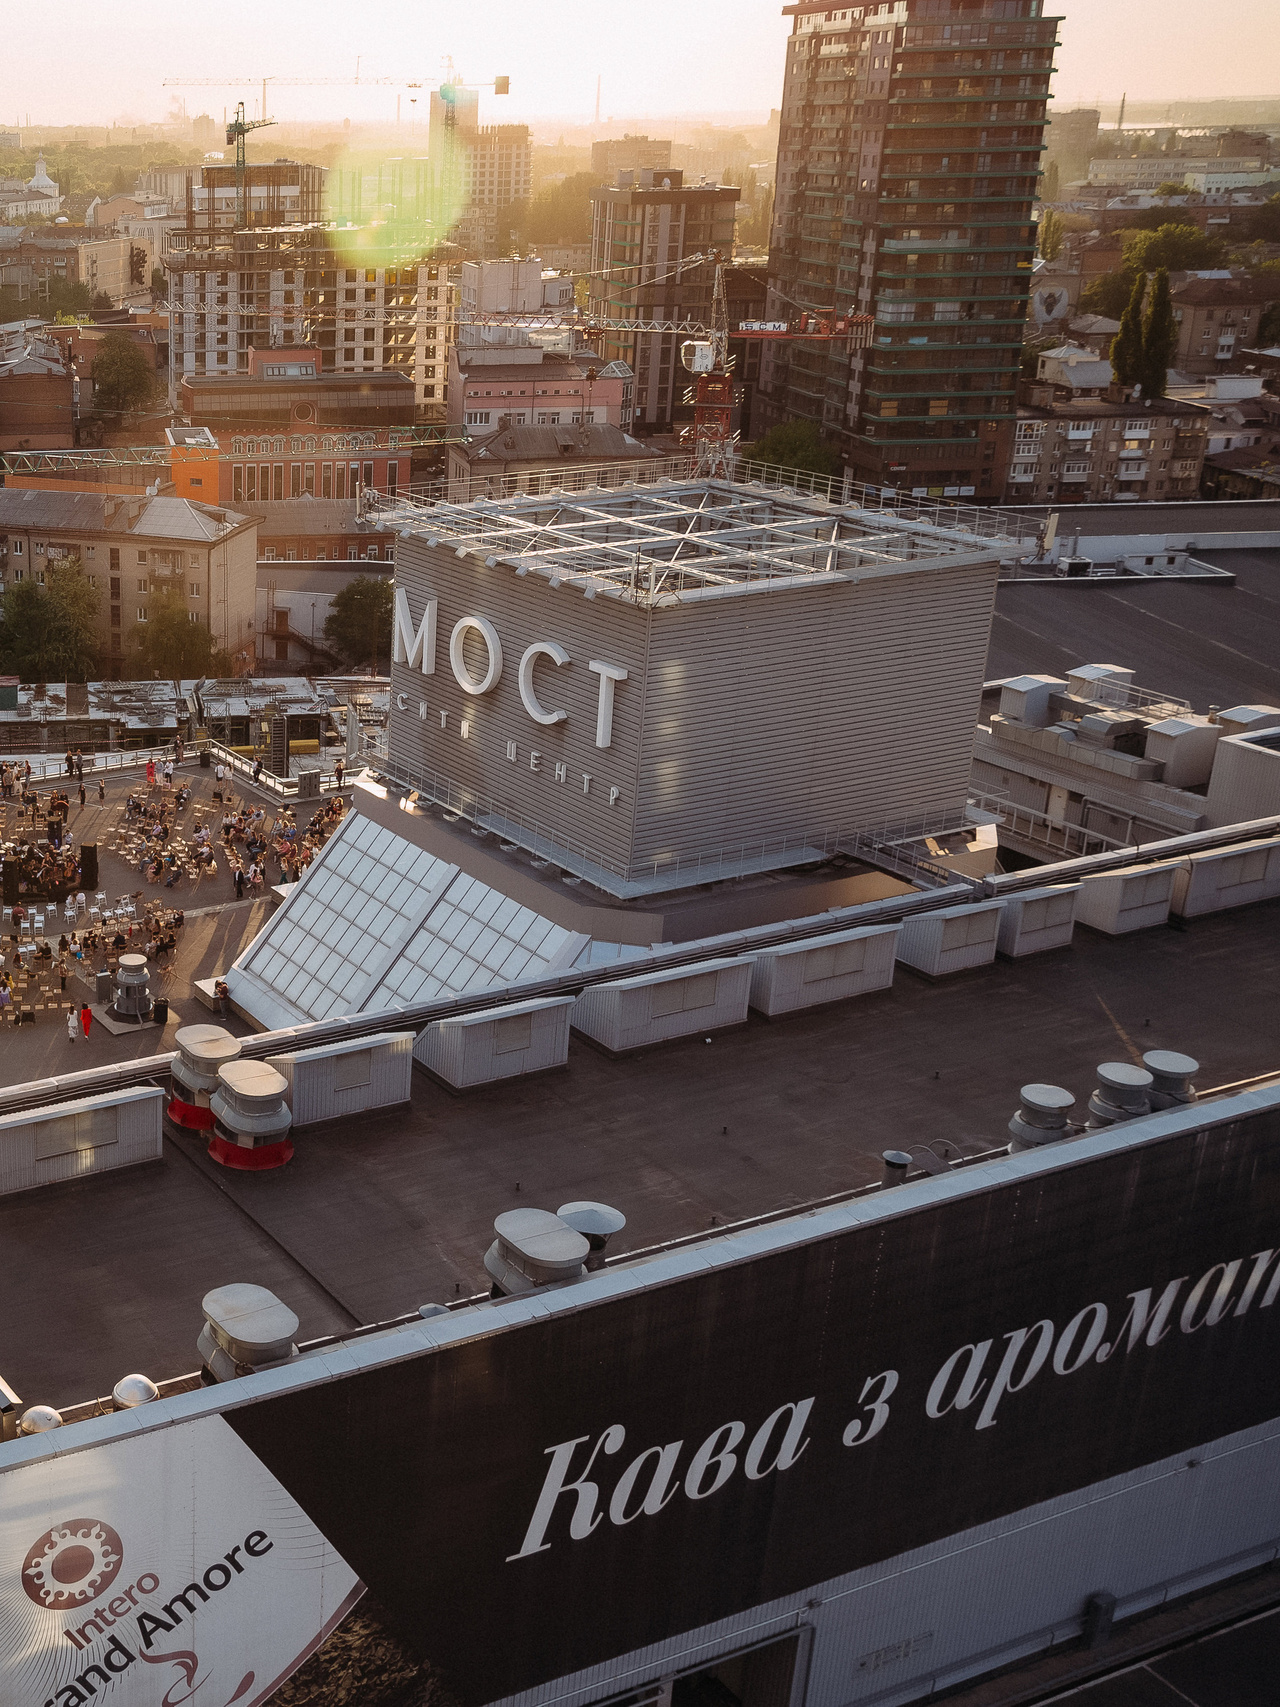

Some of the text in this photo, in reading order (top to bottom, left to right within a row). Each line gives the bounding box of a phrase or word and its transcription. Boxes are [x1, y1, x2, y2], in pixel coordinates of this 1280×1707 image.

[393, 588, 628, 748] МОСТ
[397, 694, 619, 805] СИТИ ЦЕНТР
[506, 1397, 816, 1562] Кава
[842, 1369, 899, 1447] з
[63, 1572, 161, 1651] Intero
[136, 1530, 275, 1650] Amore
